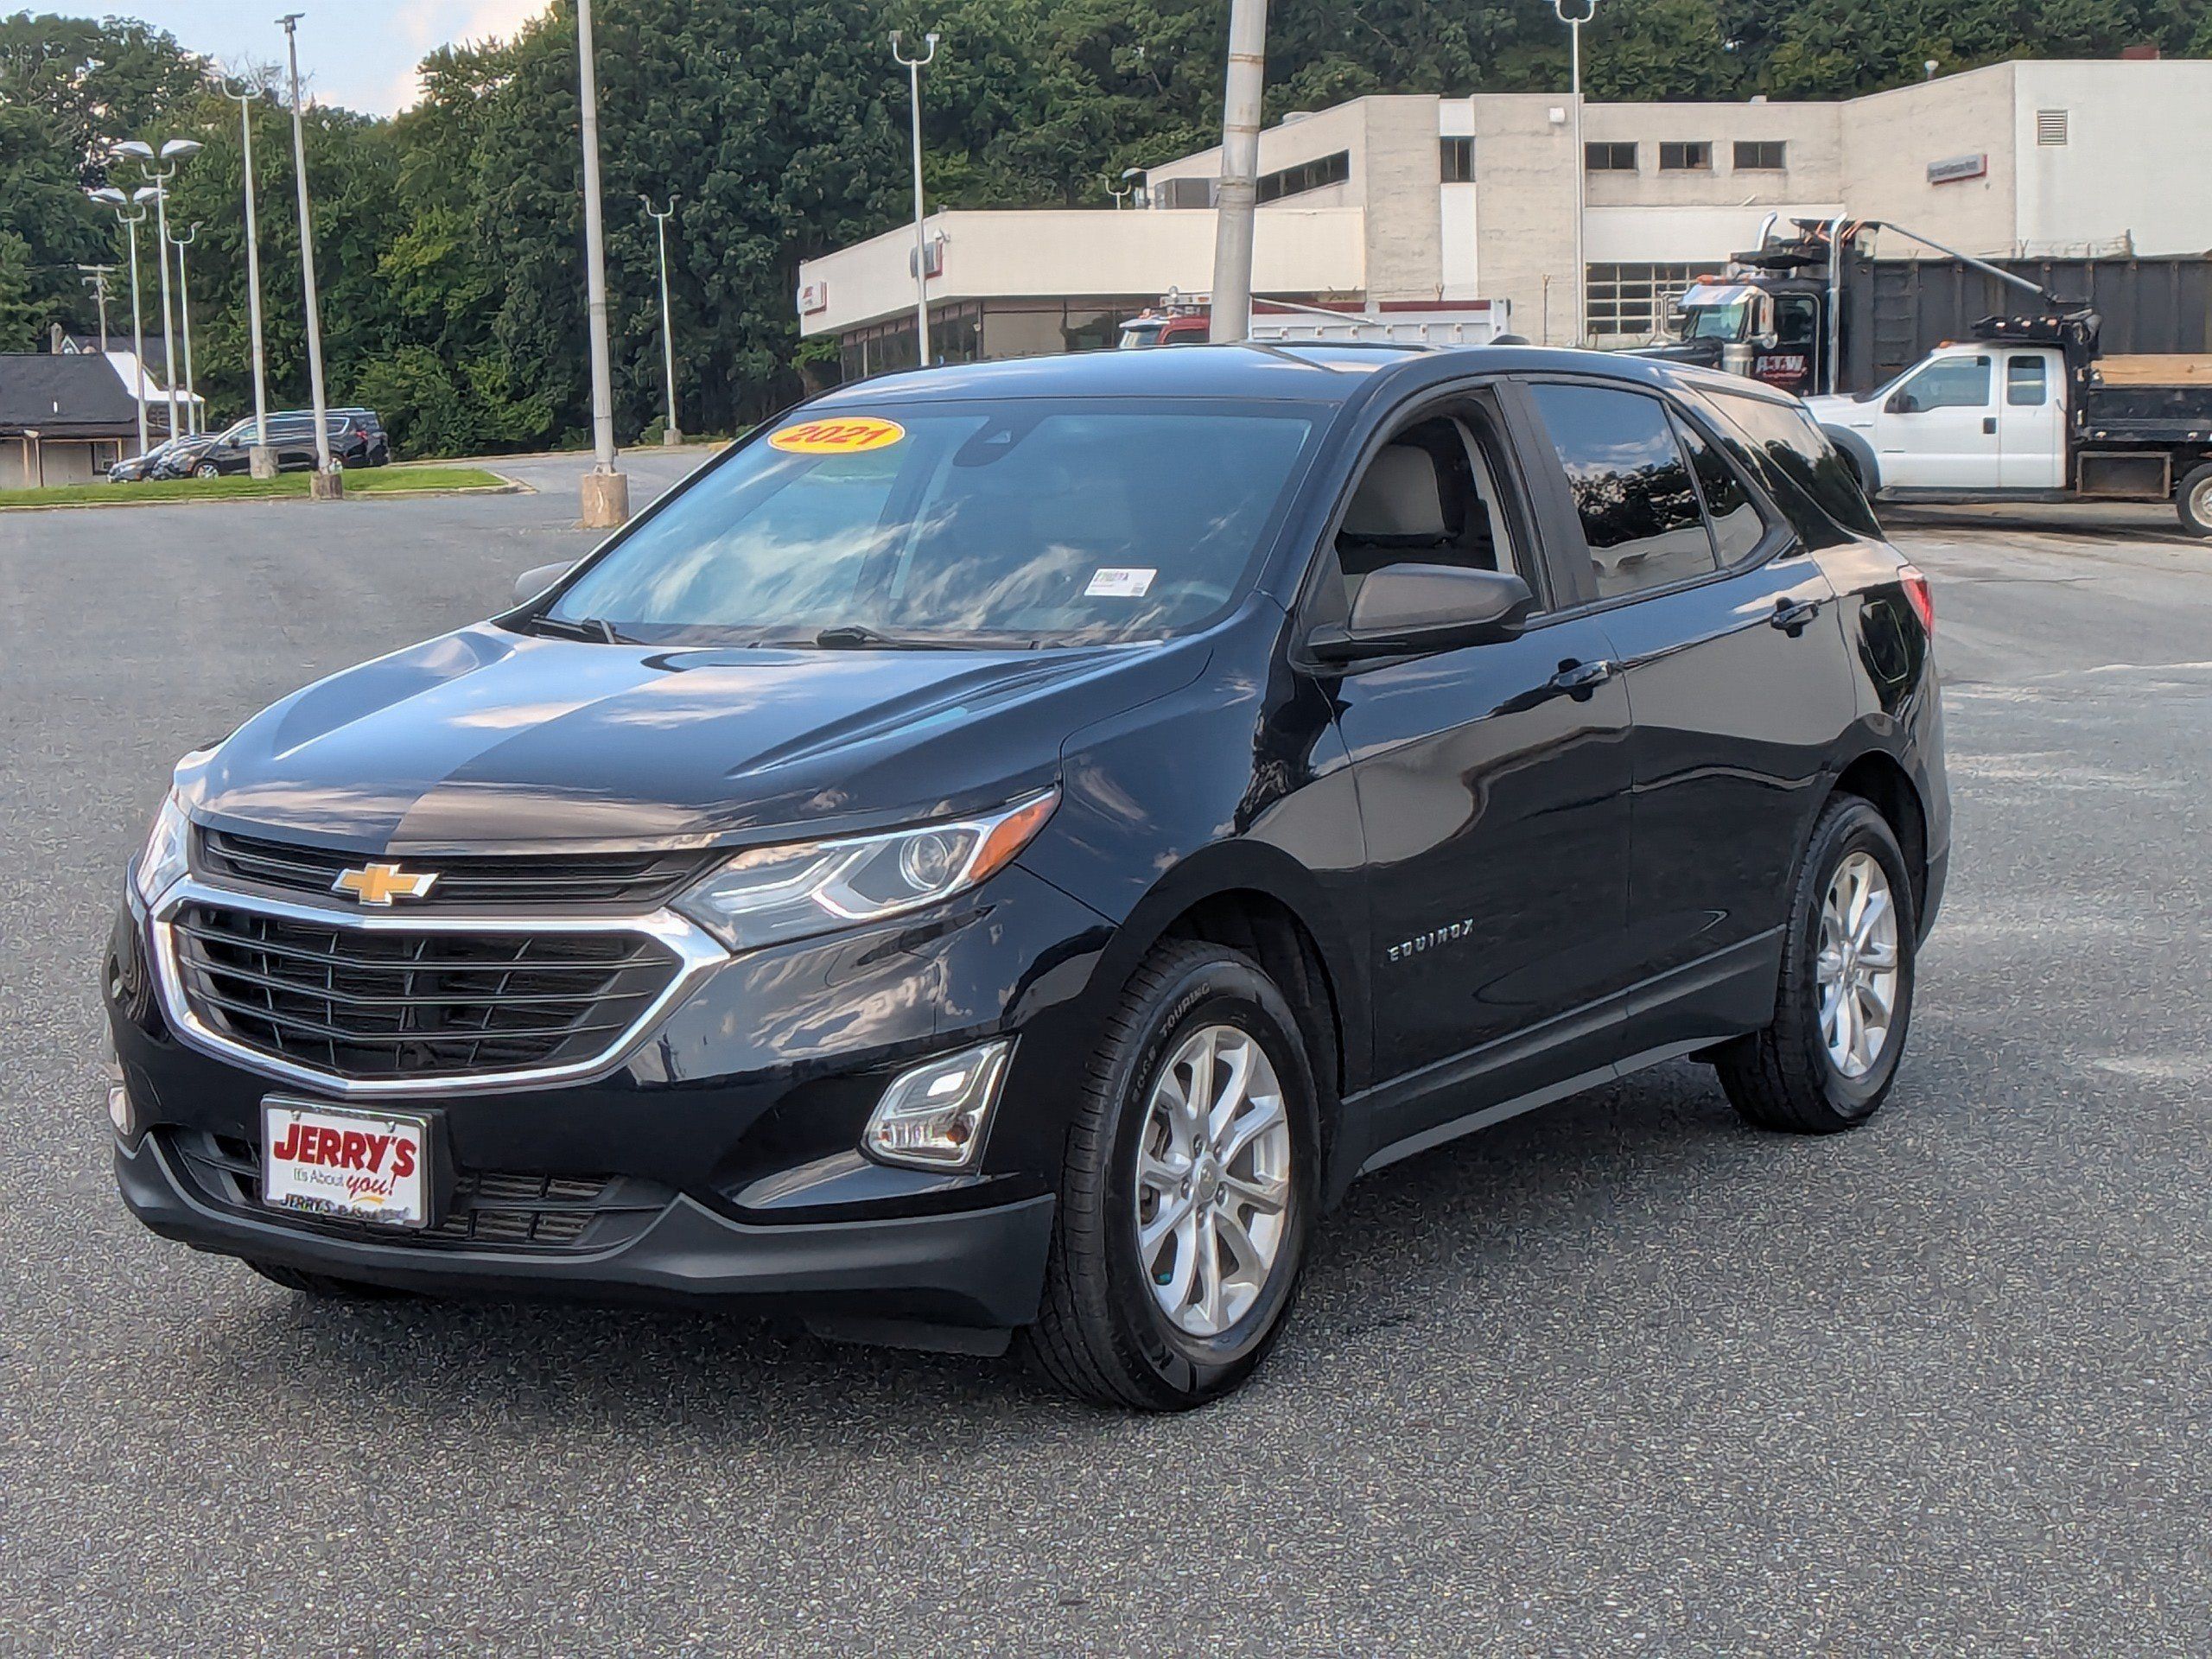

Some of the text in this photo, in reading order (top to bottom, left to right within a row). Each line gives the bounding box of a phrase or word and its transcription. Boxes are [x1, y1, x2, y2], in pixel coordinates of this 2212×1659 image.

[777, 425, 893, 446] 2021
[1387, 918, 1474, 962] EQUINOX
[1159, 982, 1211, 1037] TOURING
[273, 1122, 417, 1178] JERRY'S
[346, 1172, 396, 1199] you!
